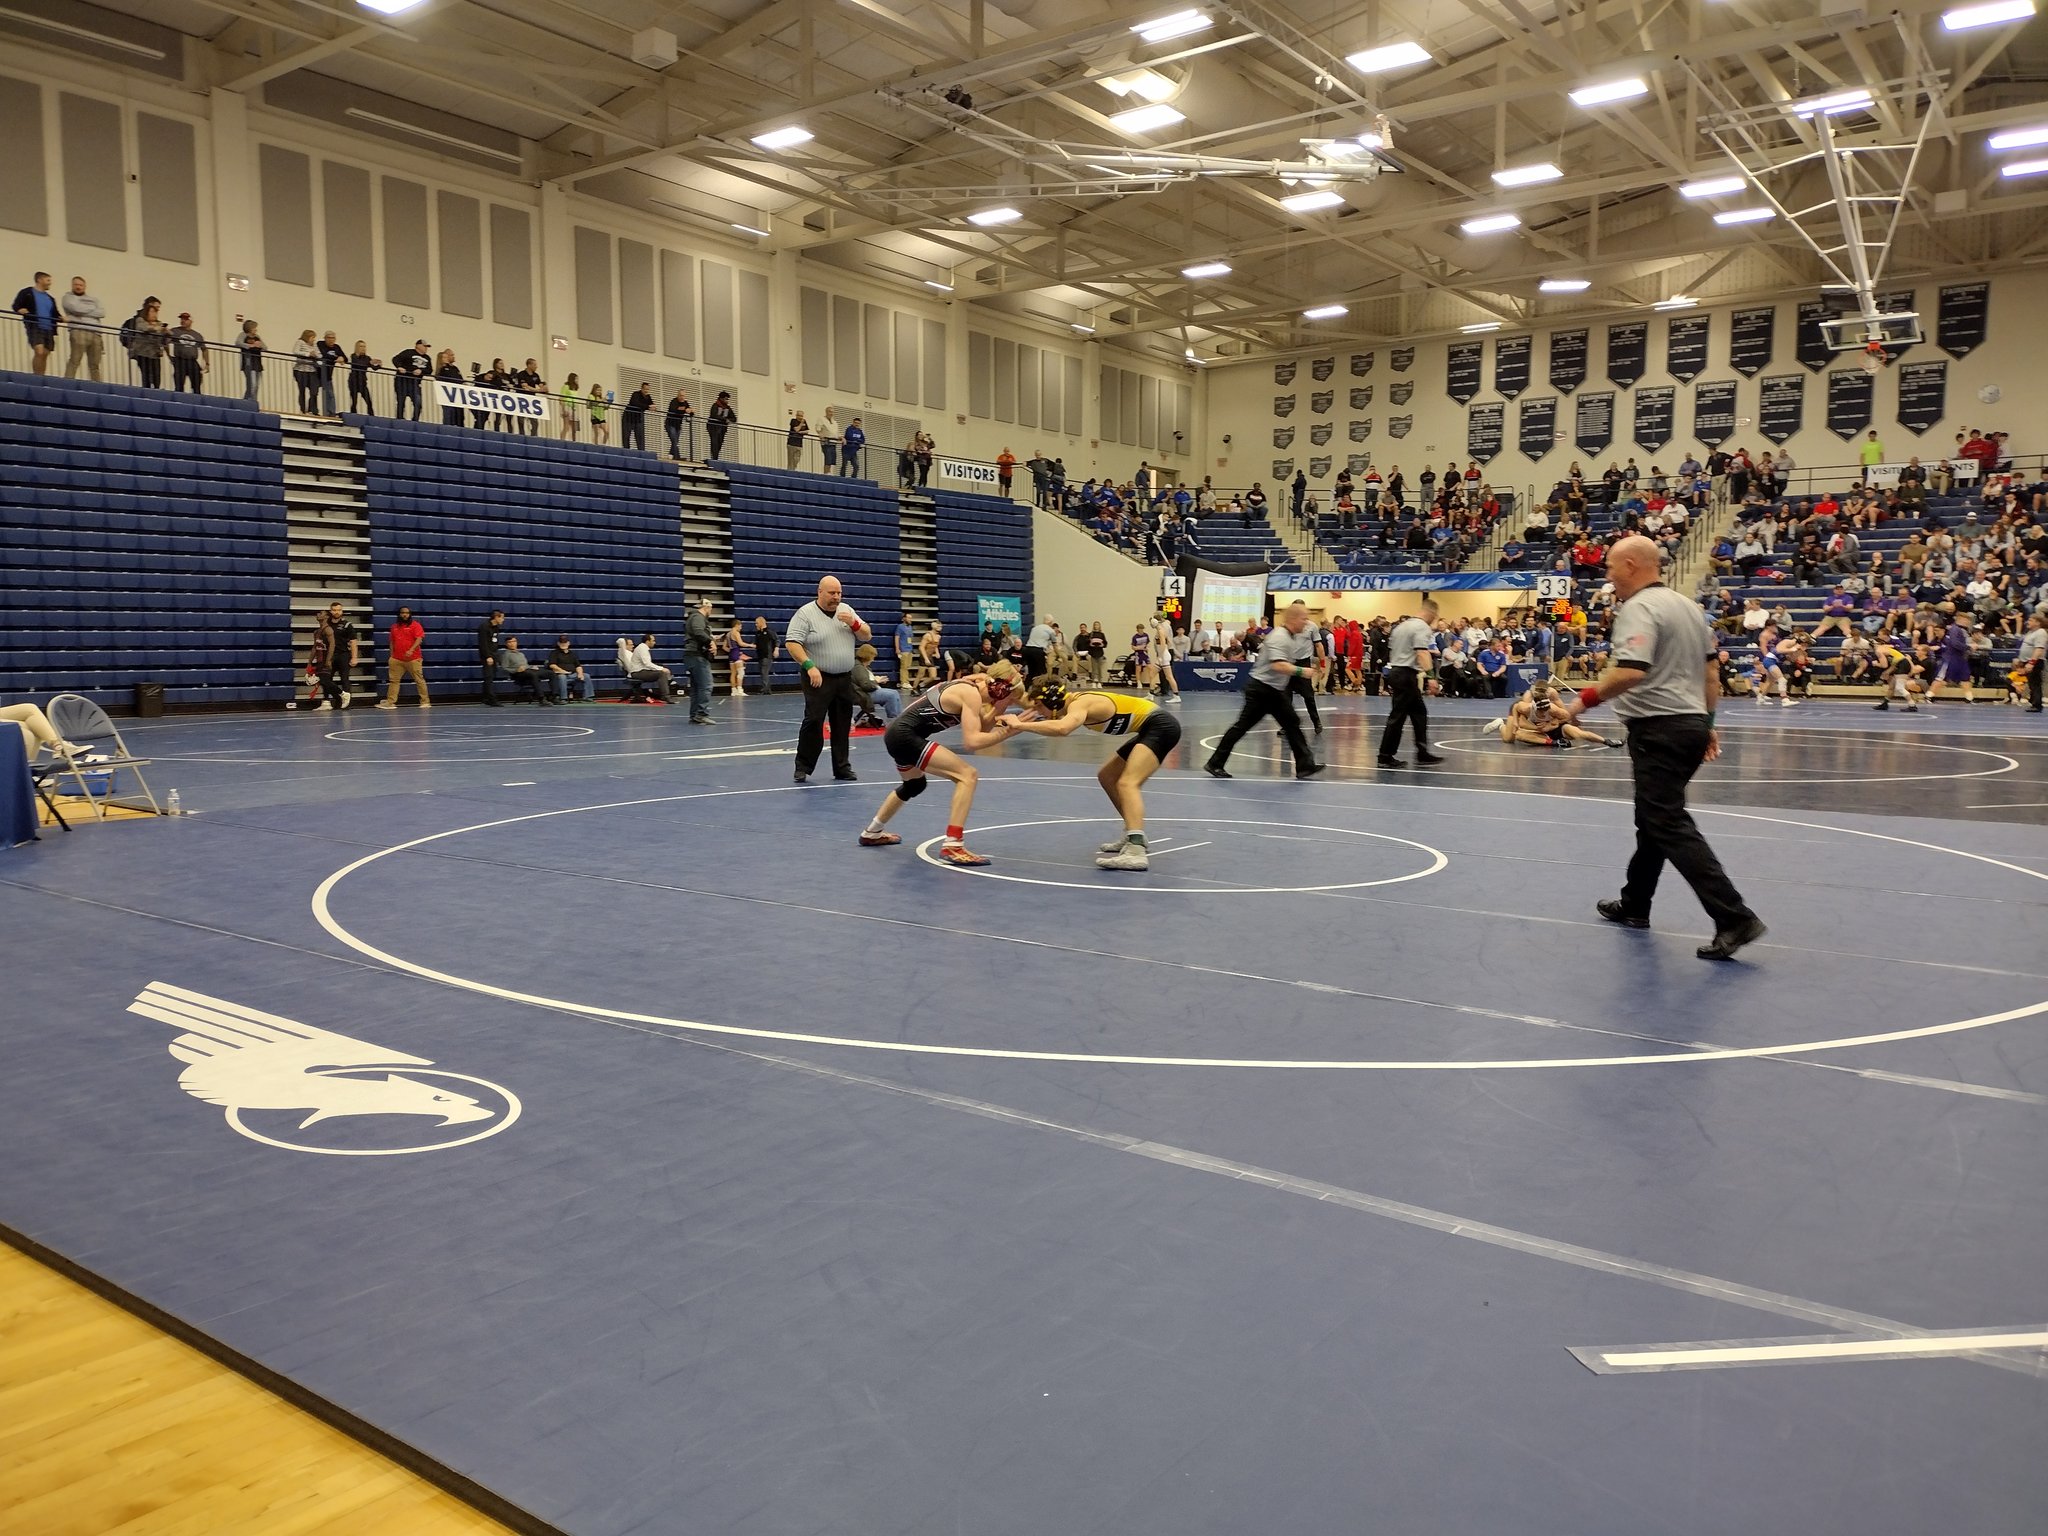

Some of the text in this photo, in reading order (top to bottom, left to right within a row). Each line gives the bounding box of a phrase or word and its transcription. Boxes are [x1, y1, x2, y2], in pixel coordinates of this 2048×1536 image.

[441, 385, 543, 416] VISITORS
[944, 463, 995, 482] VISITORS
[1170, 578, 1181, 595] 4
[1288, 574, 1389, 590] FAIRMONT
[985, 609, 1019, 621] Athletes
